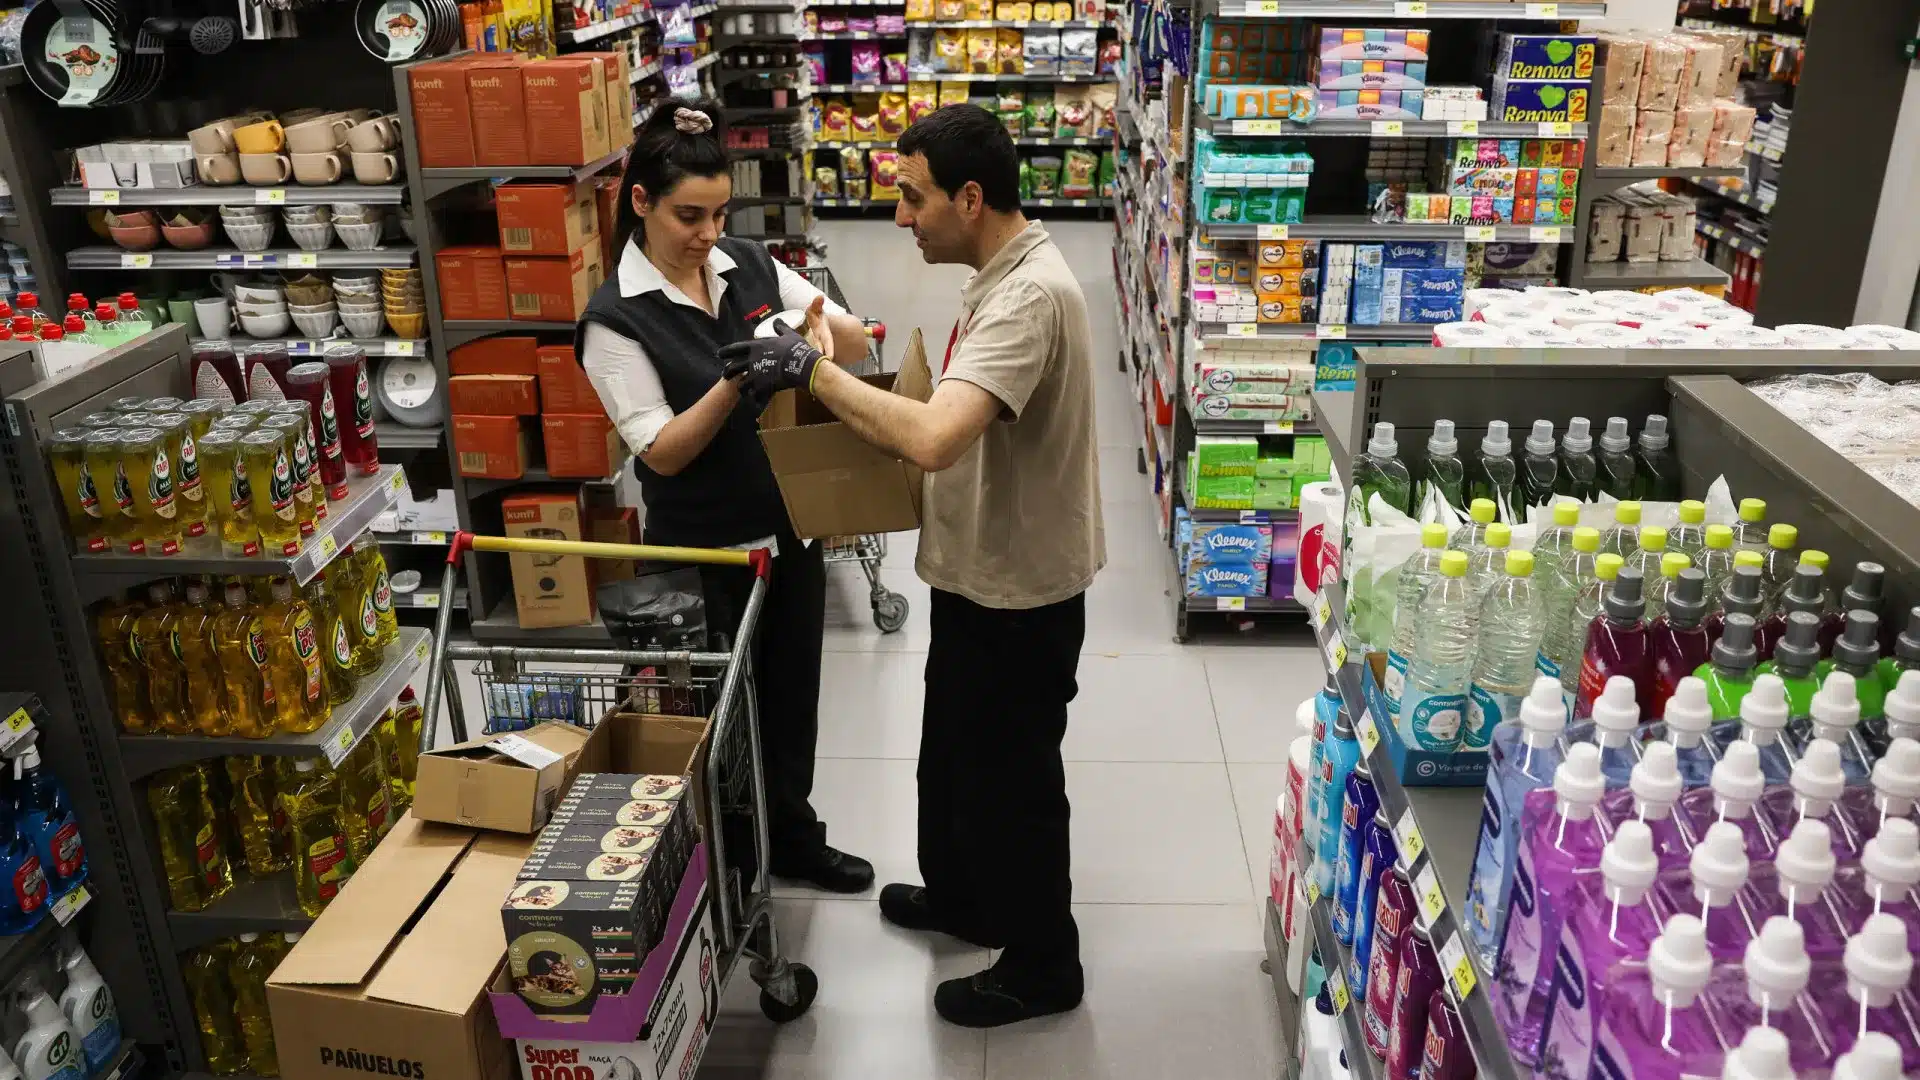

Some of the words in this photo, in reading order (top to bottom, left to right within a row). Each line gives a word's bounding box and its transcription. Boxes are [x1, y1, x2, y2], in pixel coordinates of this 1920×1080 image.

[1510, 61, 1574, 79] Renova
[1579, 51, 1593, 71] 2
[1504, 105, 1567, 122] Renova
[1572, 96, 1586, 116] 2
[753, 358, 777, 372] HyFlex
[1207, 533, 1257, 550] Kleenex
[1203, 568, 1252, 585] Kleenex
[319, 1046, 426, 1080] PAÑUELOS
[524, 1044, 580, 1070] Super
